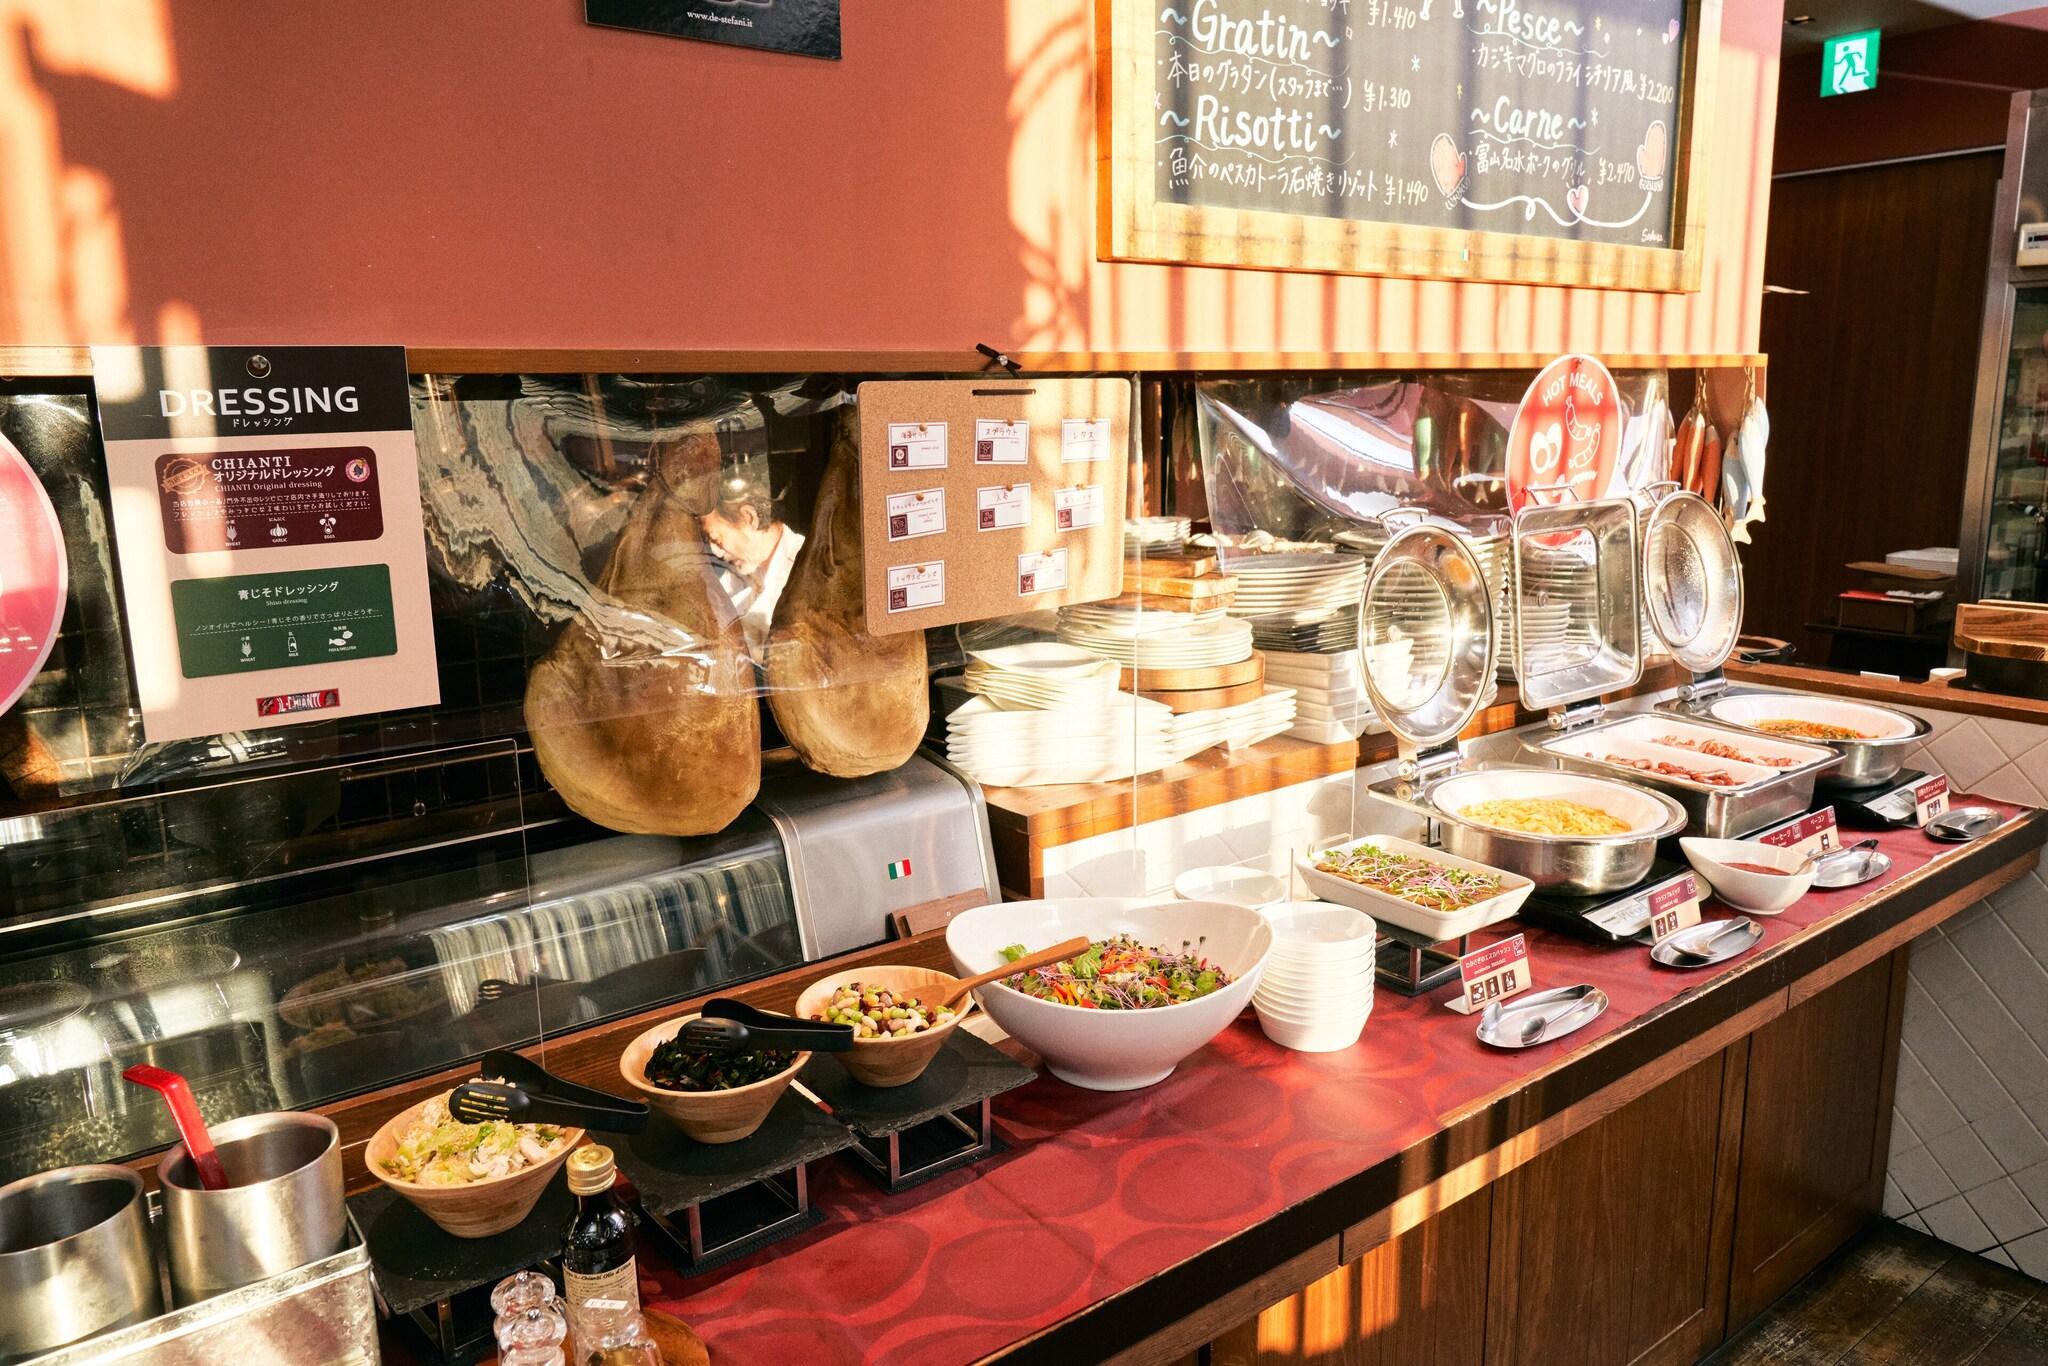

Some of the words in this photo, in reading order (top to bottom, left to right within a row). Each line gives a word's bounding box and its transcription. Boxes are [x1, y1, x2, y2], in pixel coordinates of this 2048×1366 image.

[687, 10, 753, 28] www.de-stefani.it
[1541, 375, 1566, 407] HOT
[1569, 371, 1604, 406] MEALS
[159, 386, 360, 418] DRESSING
[232, 416, 293, 428] ドレッシング
[211, 455, 292, 471] CHIANTI
[212, 465, 336, 483] オリジナルドレッシング
[215, 484, 252, 493] CHIANTI
[253, 481, 287, 491] Original
[288, 480, 323, 490] dressing
[237, 581, 340, 601] 青じそドレッシング
